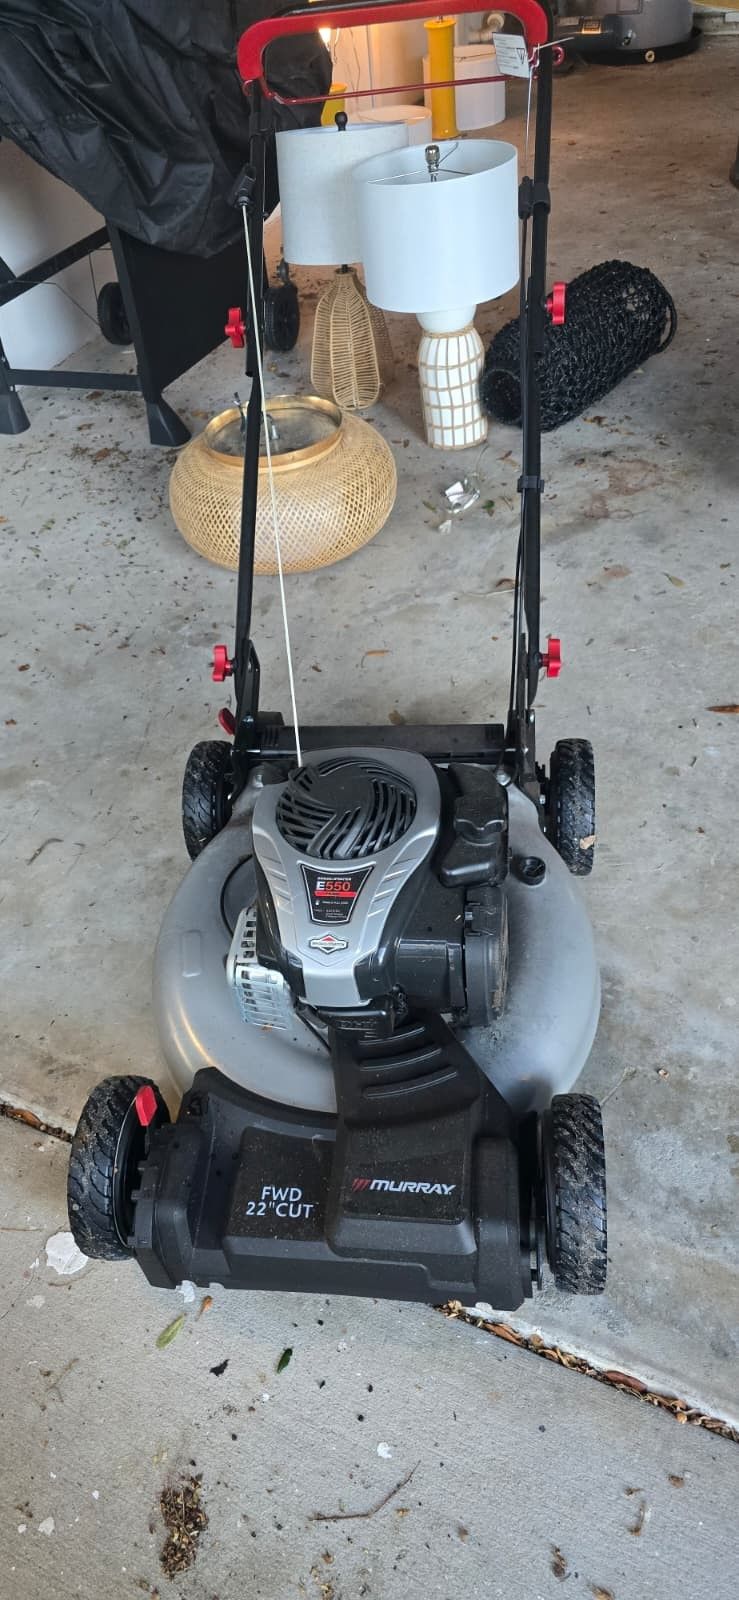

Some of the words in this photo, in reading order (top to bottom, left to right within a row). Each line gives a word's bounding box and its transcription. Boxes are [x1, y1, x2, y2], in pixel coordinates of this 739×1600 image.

[316, 881, 351, 891] E550
[261, 1186, 302, 1201] FWD
[370, 1179, 456, 1195] MURRAY
